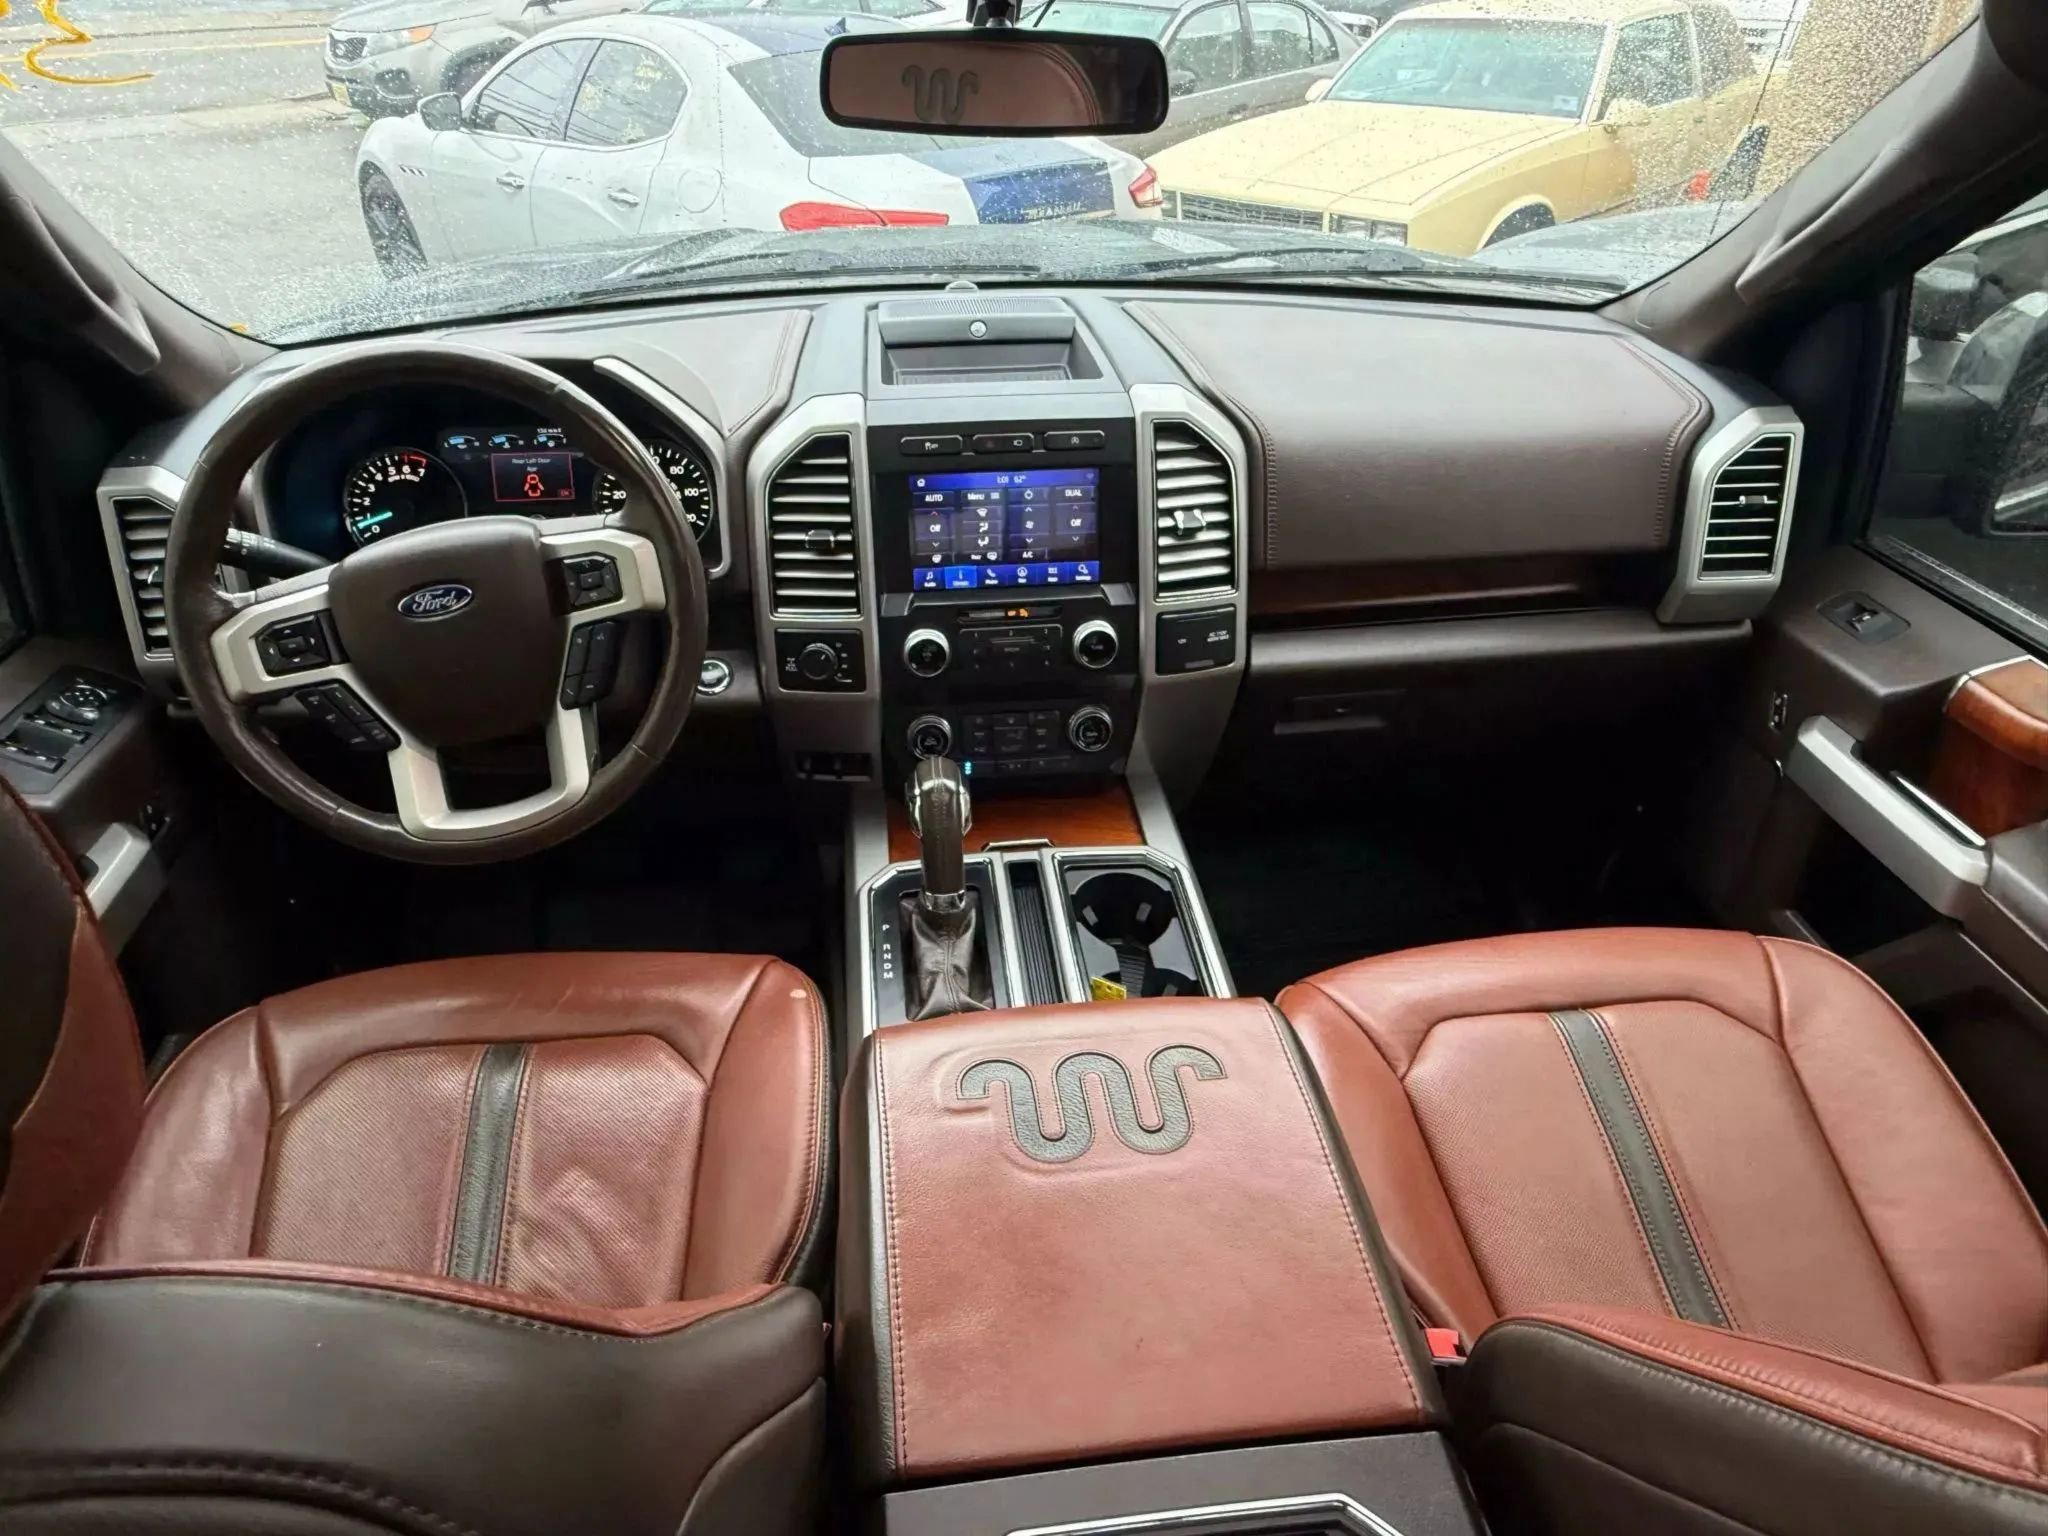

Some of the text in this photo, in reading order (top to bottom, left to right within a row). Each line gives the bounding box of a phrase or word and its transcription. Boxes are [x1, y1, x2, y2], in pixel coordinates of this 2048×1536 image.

[388, 466, 397, 476] 5
[402, 465, 411, 473] 6
[417, 468, 426, 477] 7
[669, 466, 685, 475] 80
[375, 472, 384, 481] 4
[367, 483, 376, 493] 3
[684, 488, 699, 497] 100
[612, 491, 627, 499] 20
[1064, 489, 1082, 497] DUAL
[362, 497, 371, 506] 2
[925, 494, 943, 502] AUTO
[371, 525, 380, 534] 0
[412, 589, 457, 612] Ford
[883, 952, 892, 960] N
[883, 962, 892, 970] D
[883, 971, 893, 979] M
